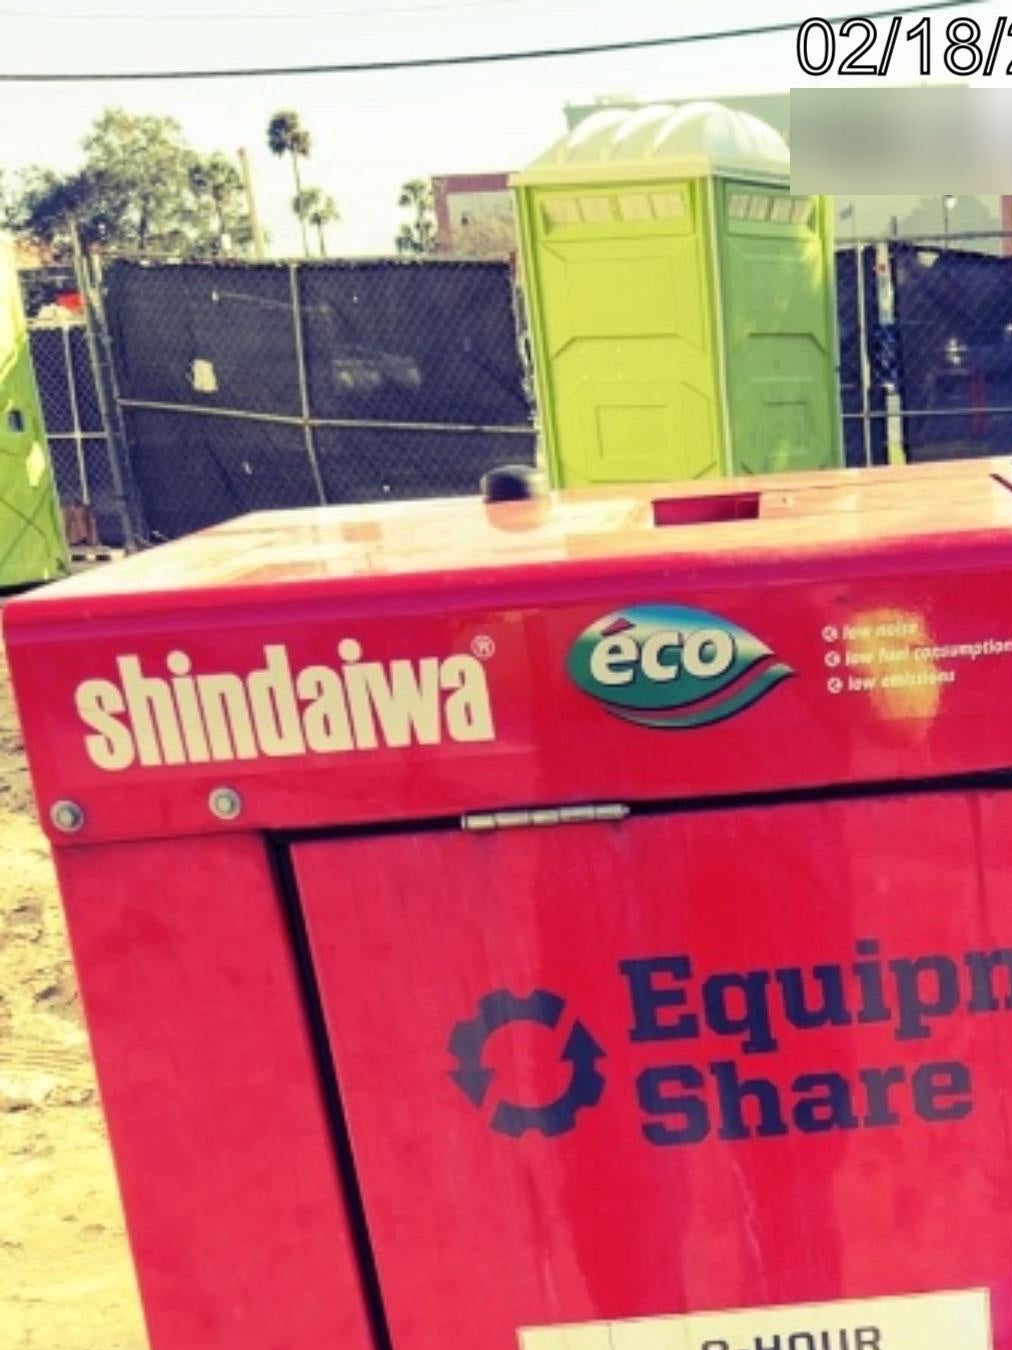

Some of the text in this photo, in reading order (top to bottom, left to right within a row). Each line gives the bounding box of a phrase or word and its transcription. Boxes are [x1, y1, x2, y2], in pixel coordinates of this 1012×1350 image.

[590, 616, 736, 686] éco
[846, 651, 873, 667] low
[848, 675, 877, 692] low
[635, 1059, 973, 1147] Share
